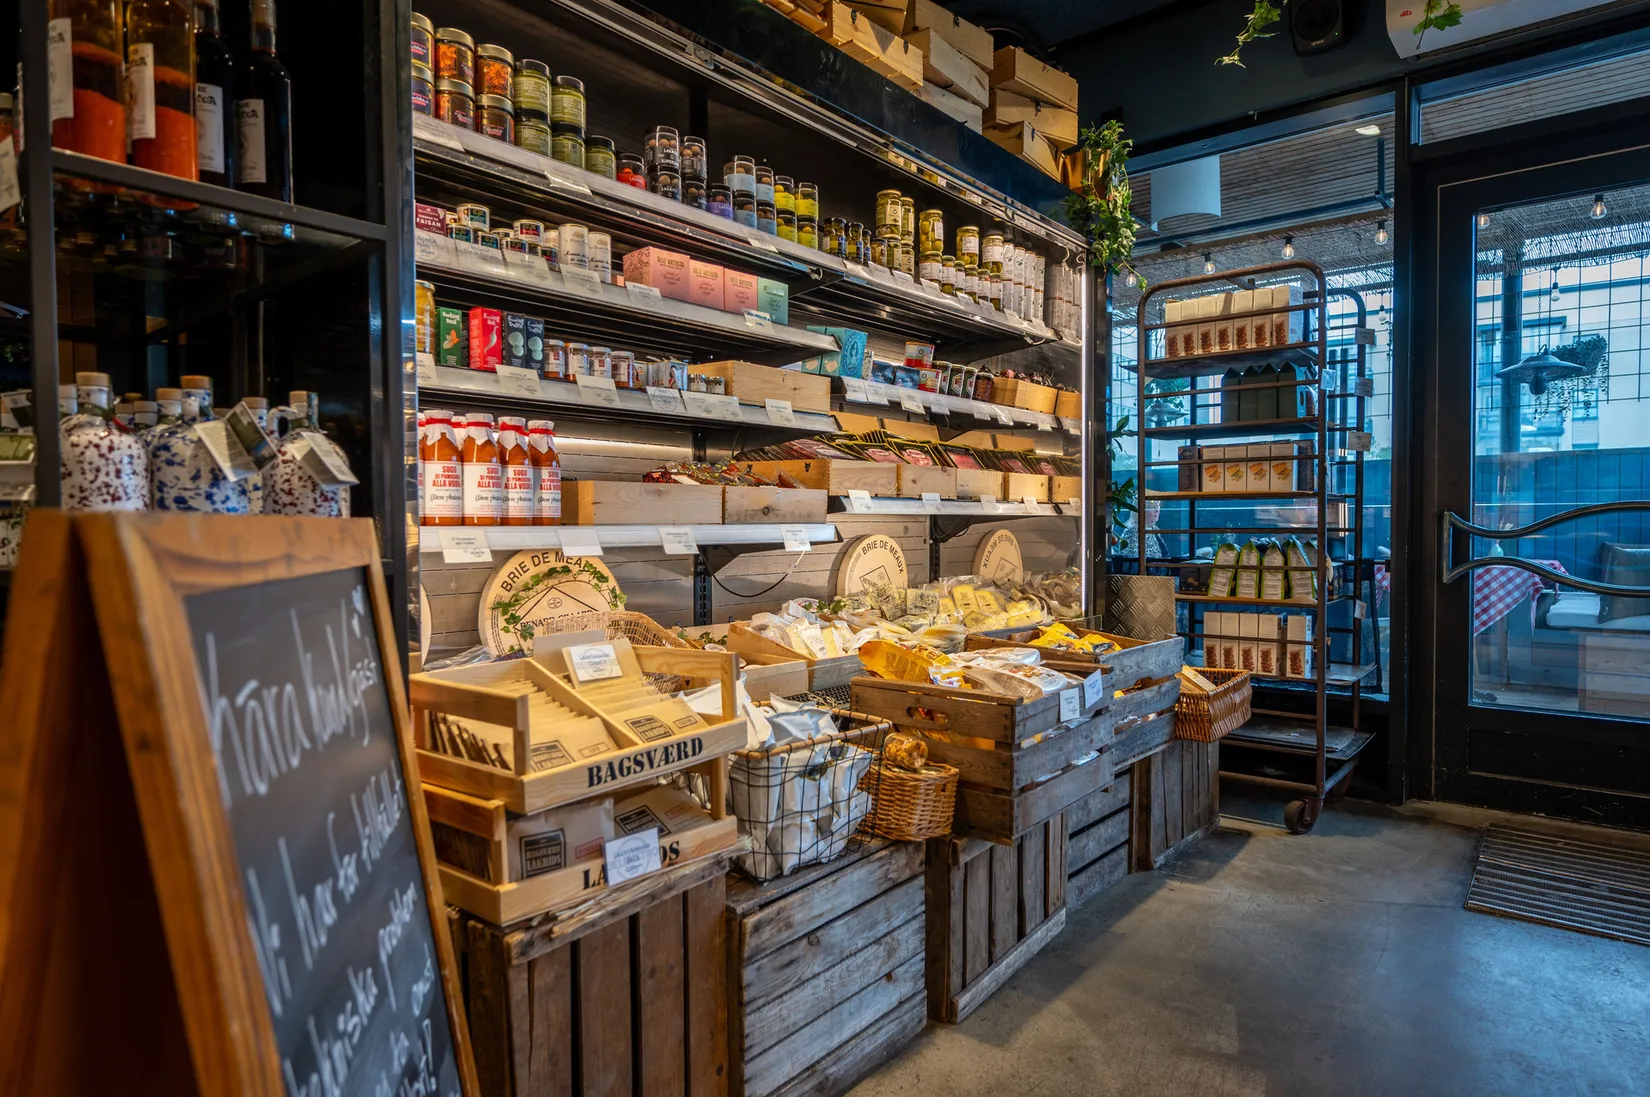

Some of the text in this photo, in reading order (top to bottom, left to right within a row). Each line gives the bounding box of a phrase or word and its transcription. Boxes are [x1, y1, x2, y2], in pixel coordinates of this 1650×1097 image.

[416, 217, 442, 228] FAISAN
[442, 465, 457, 473] SUGO
[513, 469, 528, 477] SUGO
[432, 479, 447, 487] ALLA
[477, 480, 491, 488] ALLA
[504, 482, 518, 490] ALLA
[539, 483, 552, 491] ALLA
[861, 540, 904, 575] BRIE DE MEAUX
[500, 551, 587, 593] BRIE DE MEA
[586, 736, 703, 788] BAGSVÆRD
[582, 840, 680, 890] LADS
